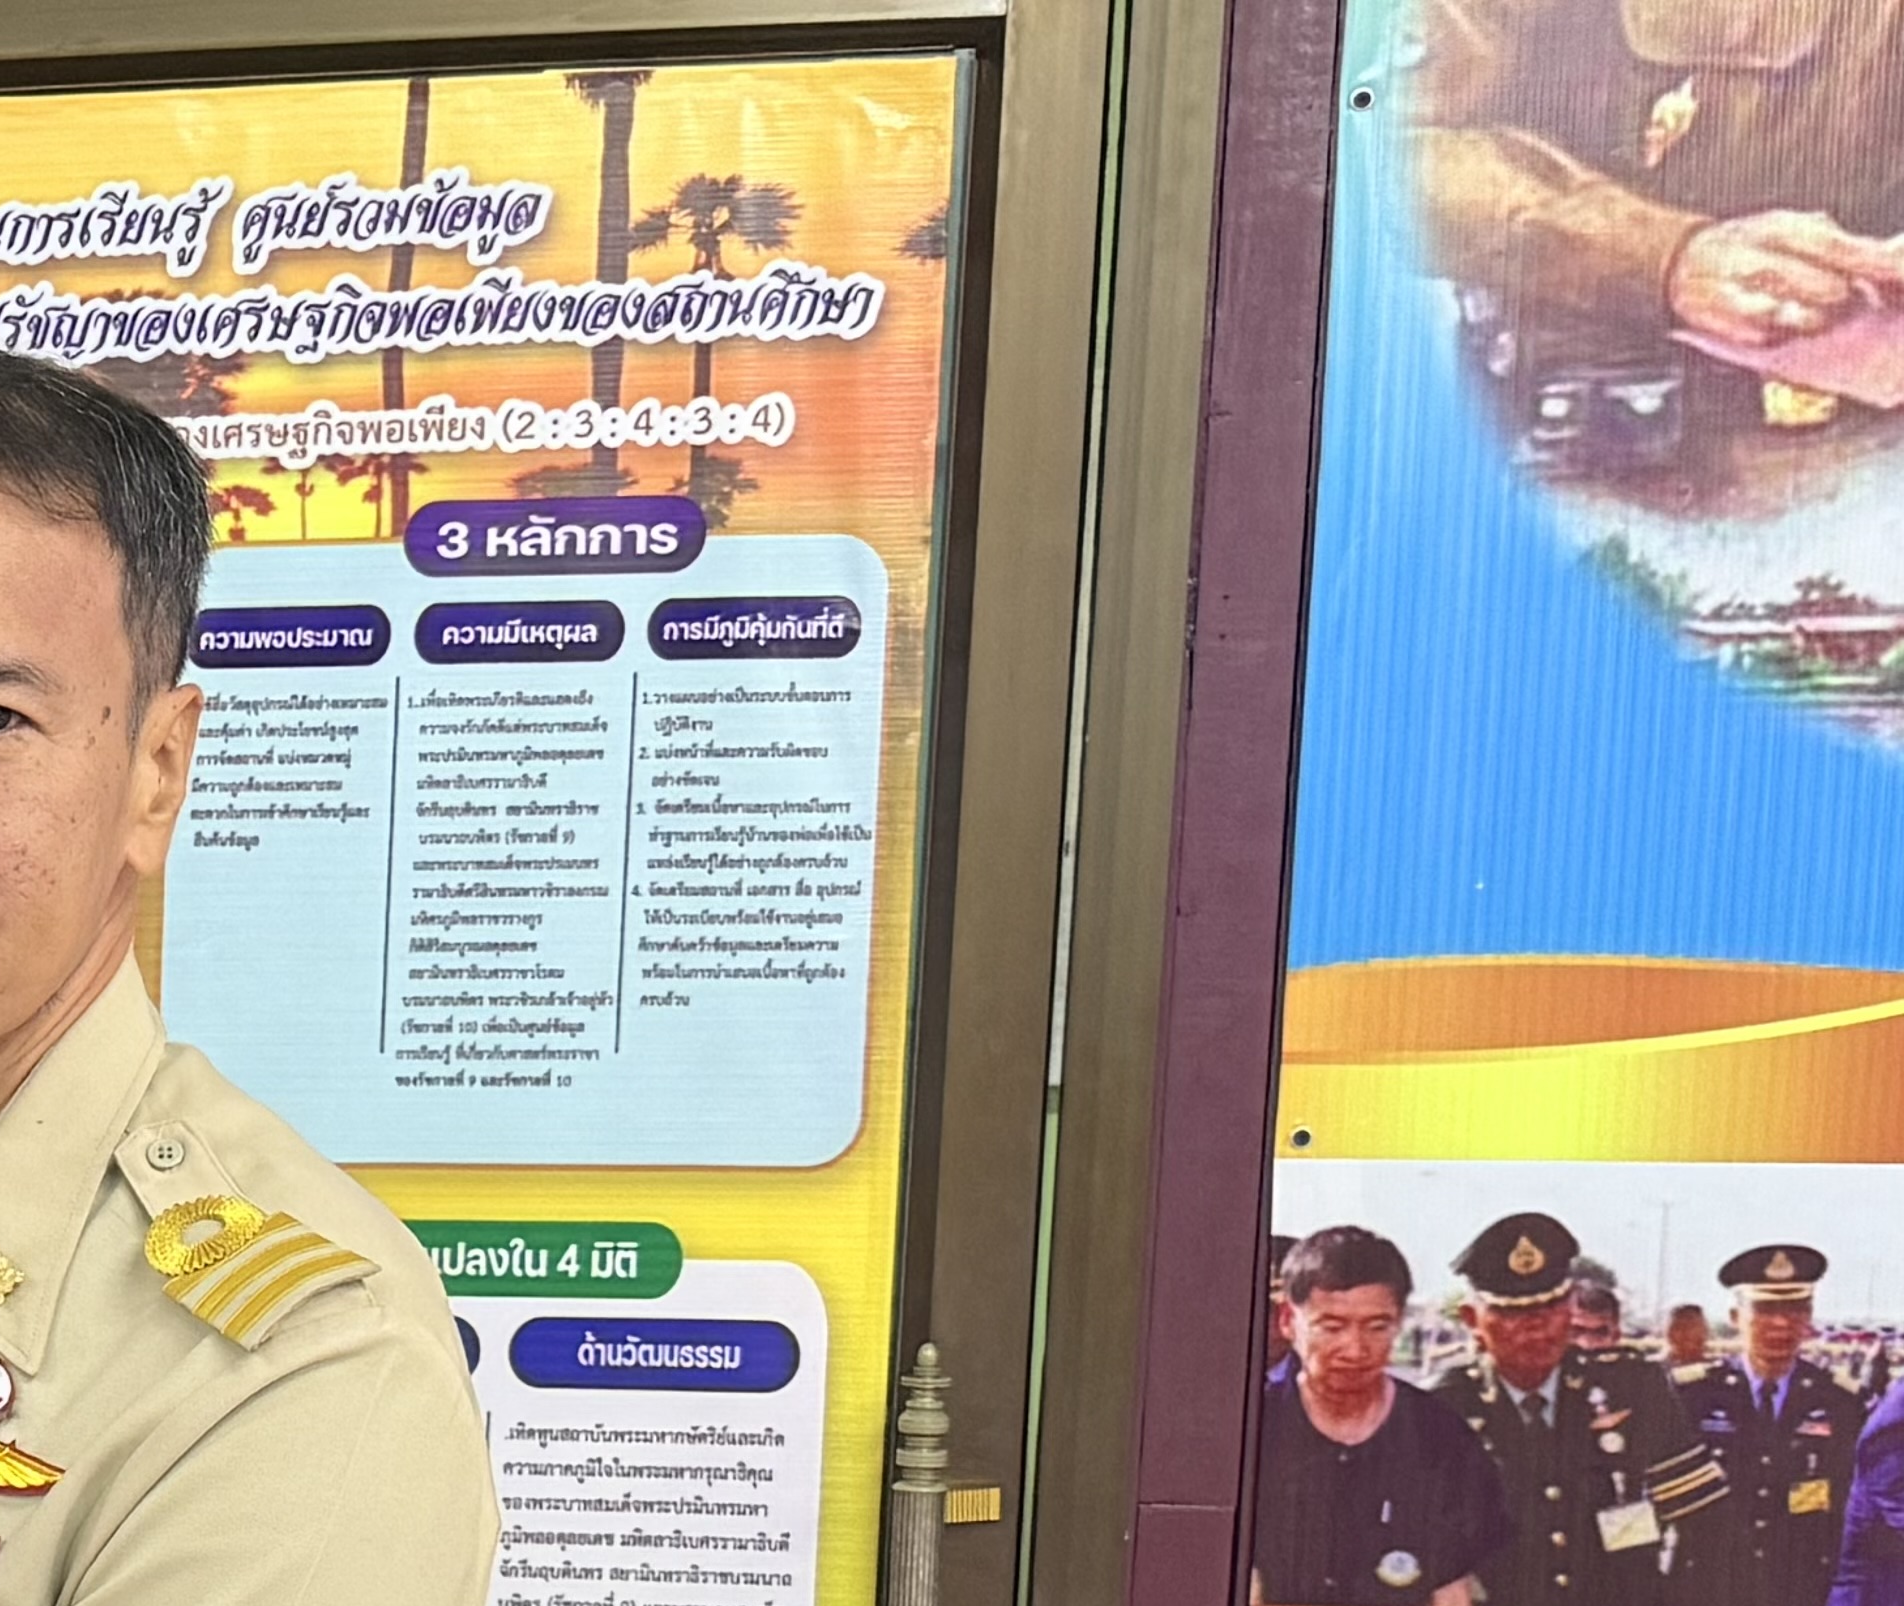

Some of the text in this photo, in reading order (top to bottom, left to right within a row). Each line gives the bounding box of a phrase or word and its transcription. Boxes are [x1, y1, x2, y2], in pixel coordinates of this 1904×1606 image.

[240, 174, 543, 267] ศูนย์รวมข้อมูล
[437, 514, 679, 560] 3 หลักการ
[200, 626, 373, 652] ความพอประมาณ
[442, 620, 597, 652] ความมีเหตุผล
[663, 607, 846, 649] การมีภูมิคุ้มกันที่ดี
[557, 1244, 579, 1278] 4
[592, 1242, 638, 1278] มิติ
[578, 1331, 741, 1370] ด้านวัฒนธรรม
